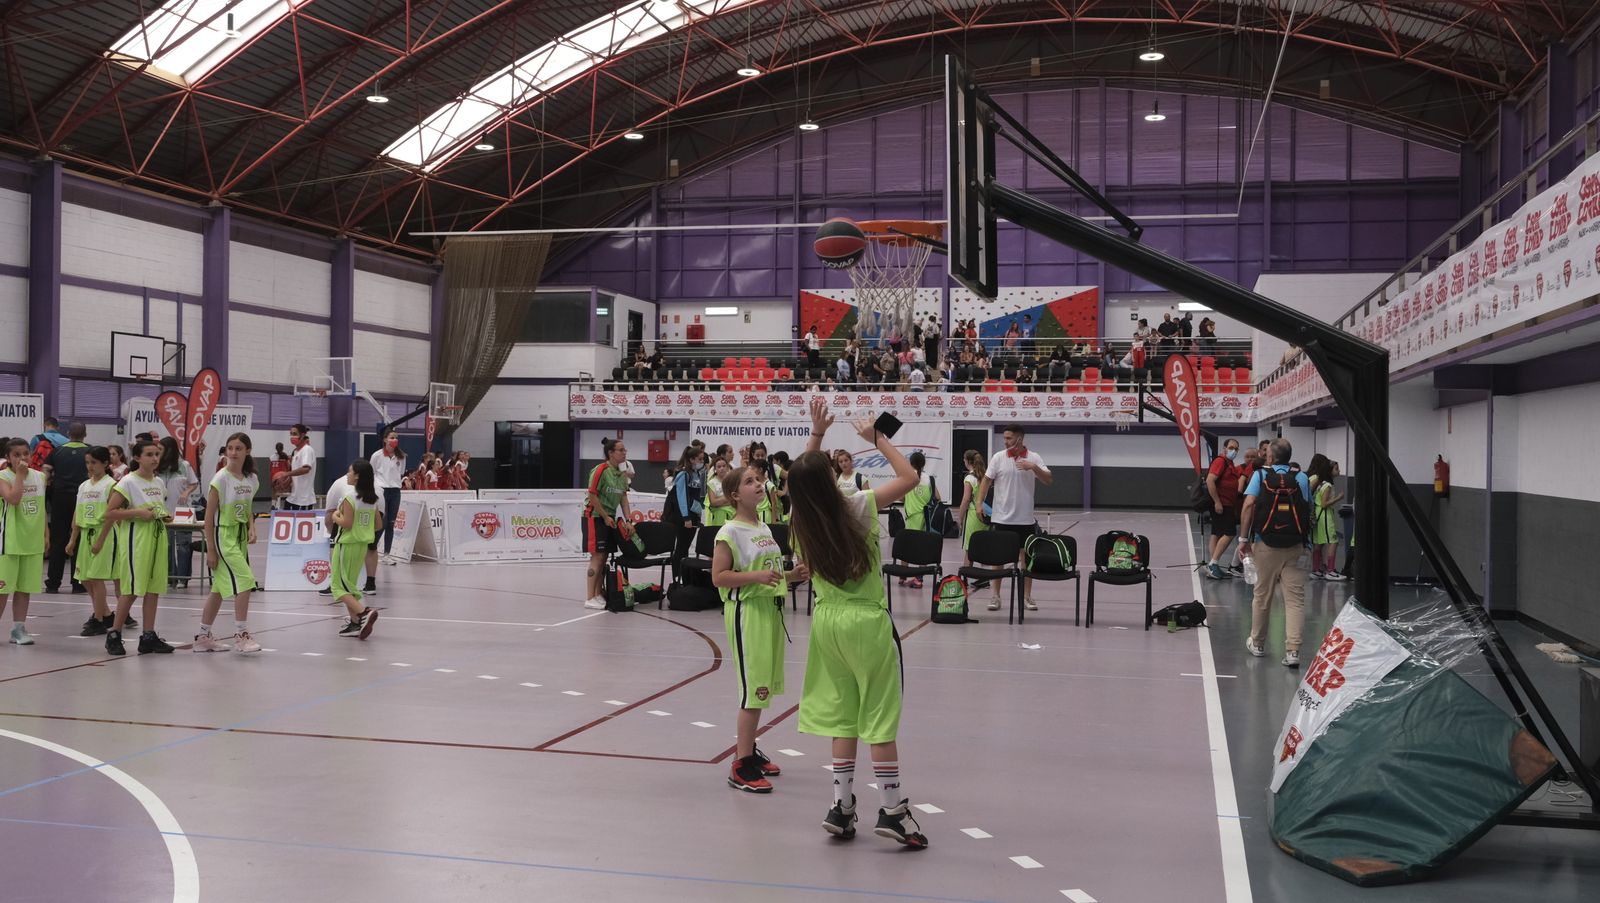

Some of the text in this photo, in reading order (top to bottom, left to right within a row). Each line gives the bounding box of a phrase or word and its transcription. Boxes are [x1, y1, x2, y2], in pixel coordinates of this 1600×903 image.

[190, 374, 215, 446] COVAP
[1171, 360, 1197, 449] COVAP
[219, 414, 247, 426] VIATOR
[696, 426, 810, 437] AYUNTAMIENTO DE VIATOR
[23, 500, 38, 515] 15
[86, 505, 95, 519] 2
[275, 520, 313, 541] 0 0
[516, 526, 562, 538] COVAP
